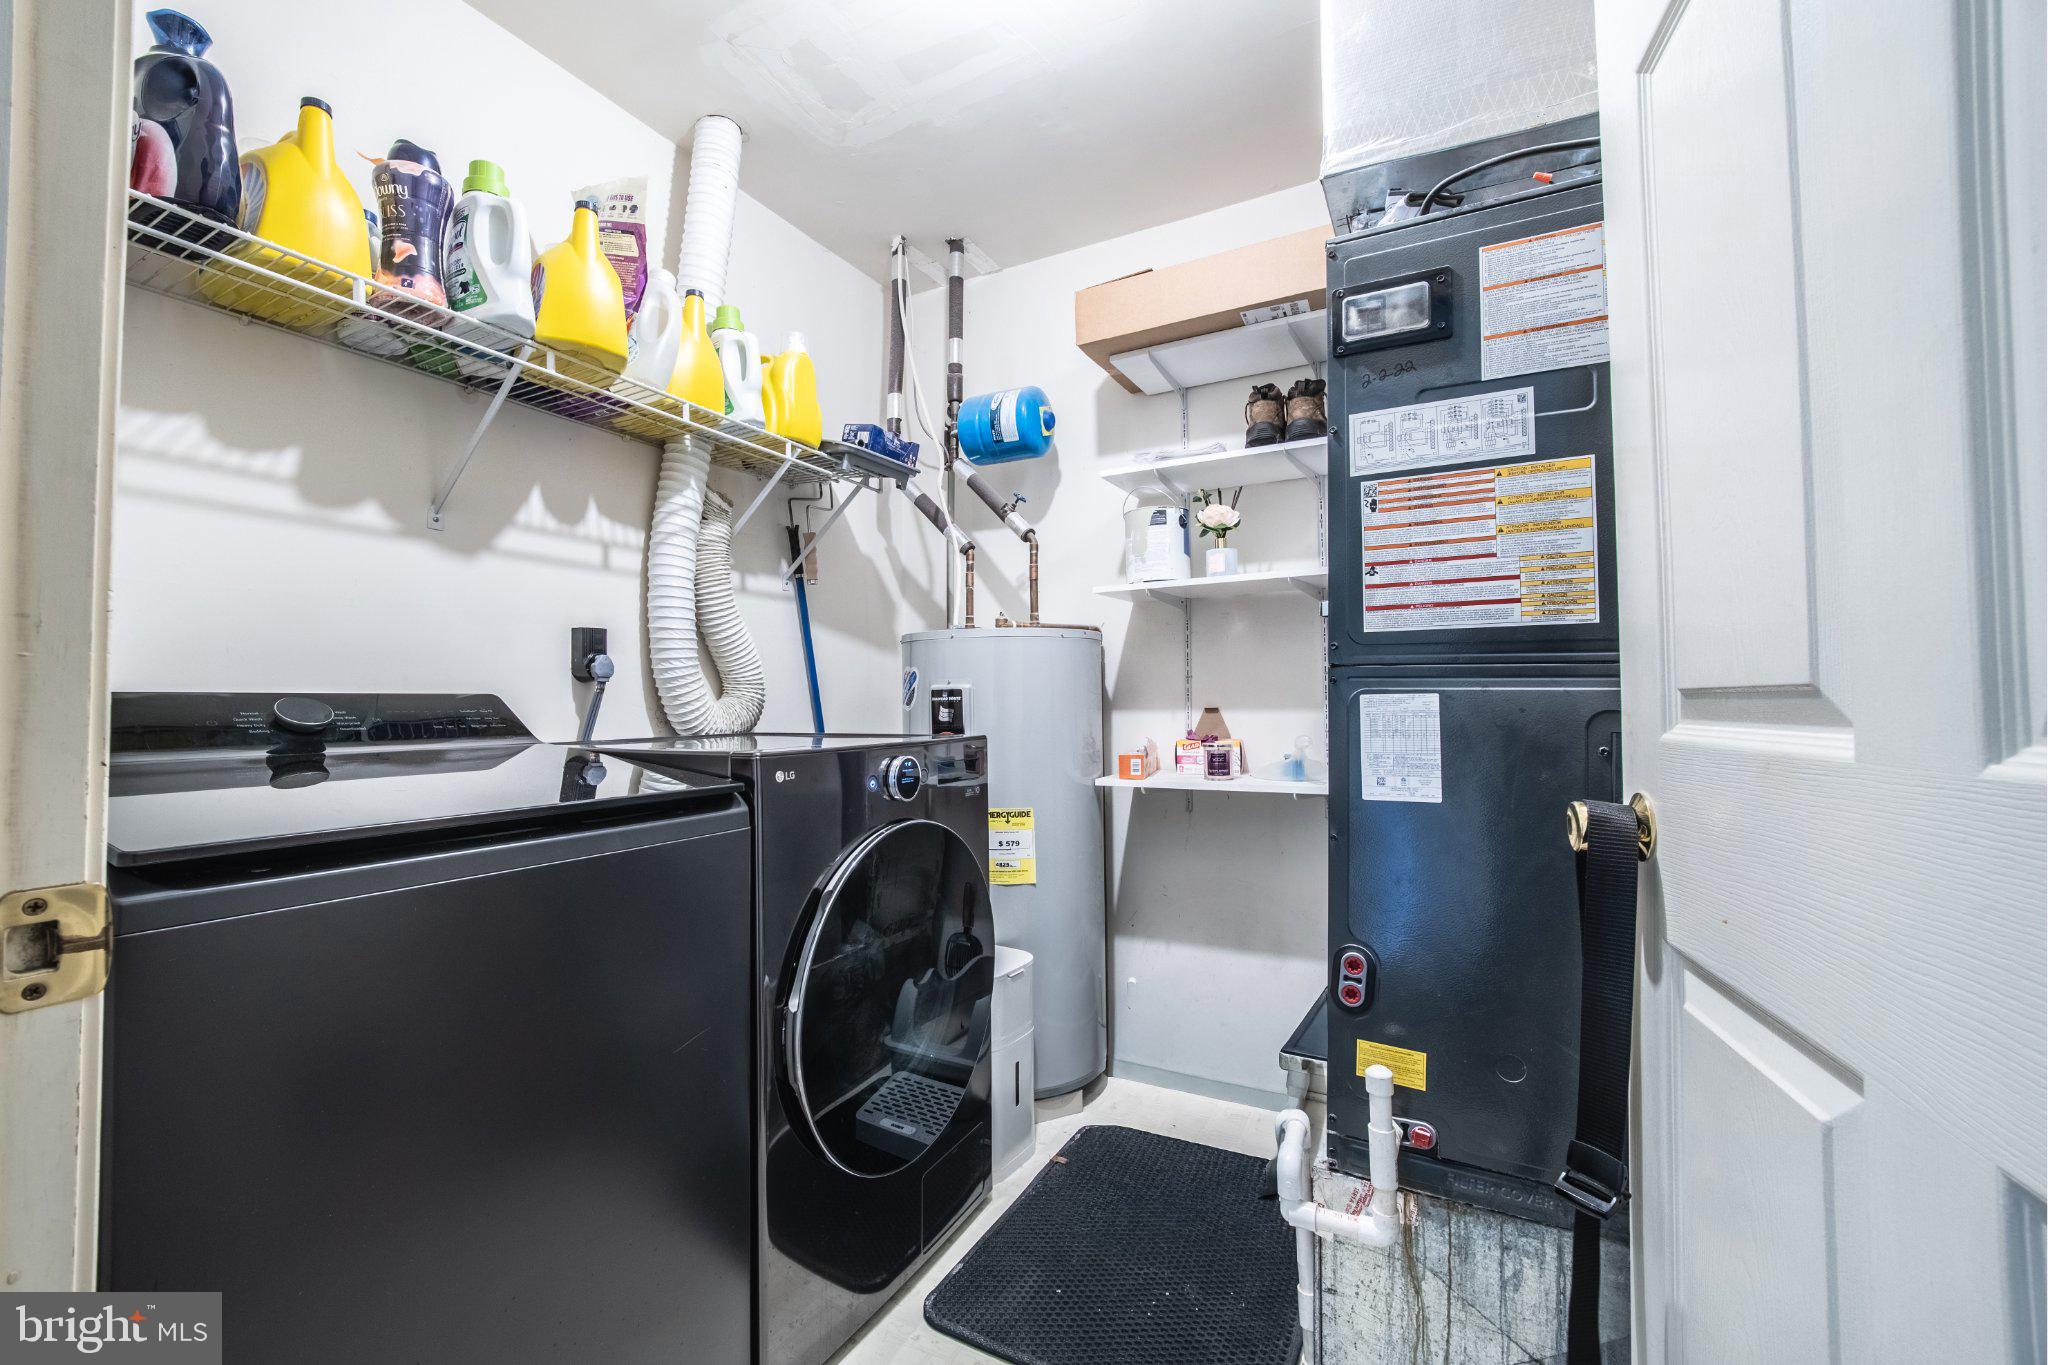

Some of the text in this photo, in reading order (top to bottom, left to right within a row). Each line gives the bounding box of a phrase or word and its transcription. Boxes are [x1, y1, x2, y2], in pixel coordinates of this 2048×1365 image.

[375, 183, 409, 200] owny
[381, 204, 406, 219] LISS
[785, 771, 796, 781] LG
[988, 811, 1031, 819] NERGYGUIDE
